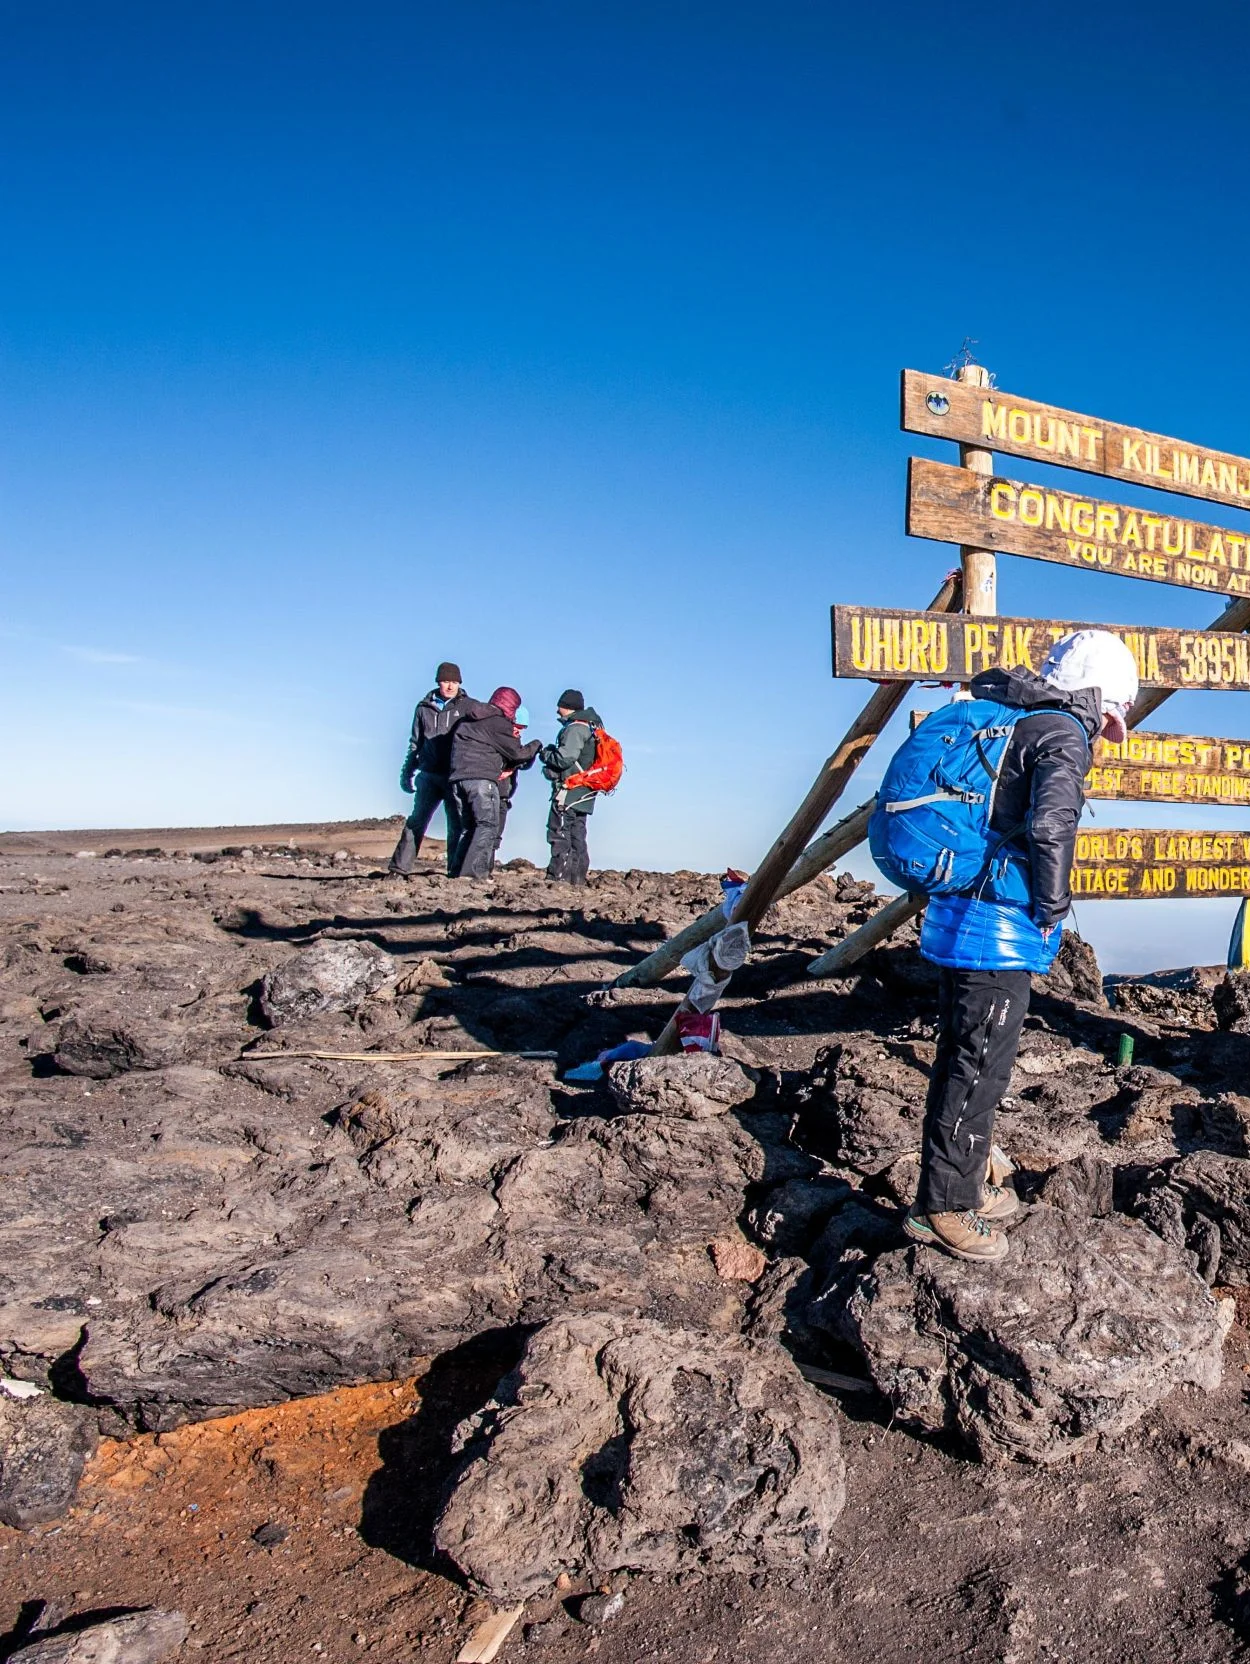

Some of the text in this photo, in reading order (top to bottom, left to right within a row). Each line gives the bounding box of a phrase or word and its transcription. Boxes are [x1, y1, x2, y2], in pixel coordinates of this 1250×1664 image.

[981, 400, 1104, 462] MOUNT
[1067, 539, 1250, 592] YOU ARE NOW AT
[851, 616, 948, 674] UHURU
[964, 622, 1041, 676] PEAK
[1103, 737, 1213, 767] HIGHEST
[1154, 835, 1235, 861] LARGEST
[1140, 867, 1177, 892] AND
[1186, 866, 1250, 892] WONDER
